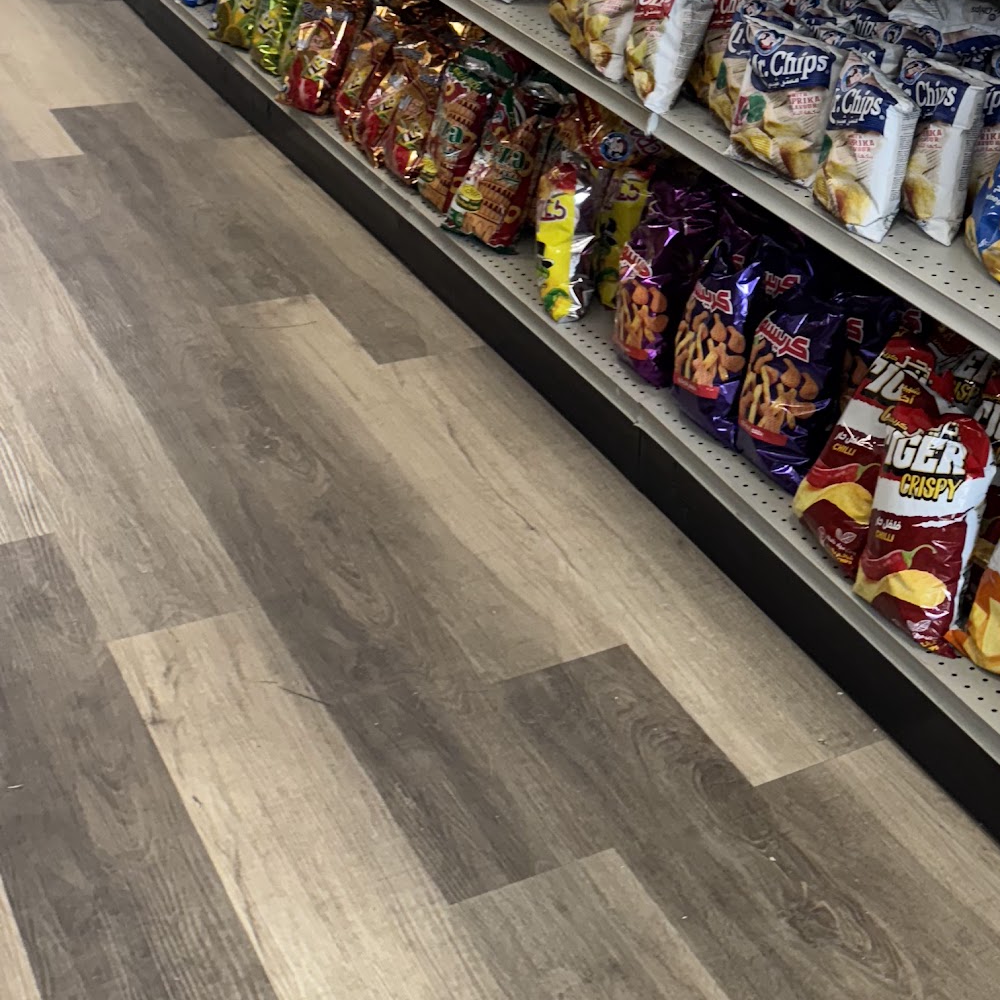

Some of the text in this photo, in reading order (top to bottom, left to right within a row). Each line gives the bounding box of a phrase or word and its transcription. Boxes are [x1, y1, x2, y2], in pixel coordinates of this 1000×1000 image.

[769, 50, 828, 80] Chips
[839, 89, 882, 121] Chips
[832, 444, 856, 456] CHILLI
[899, 473, 962, 500] CRISPY
